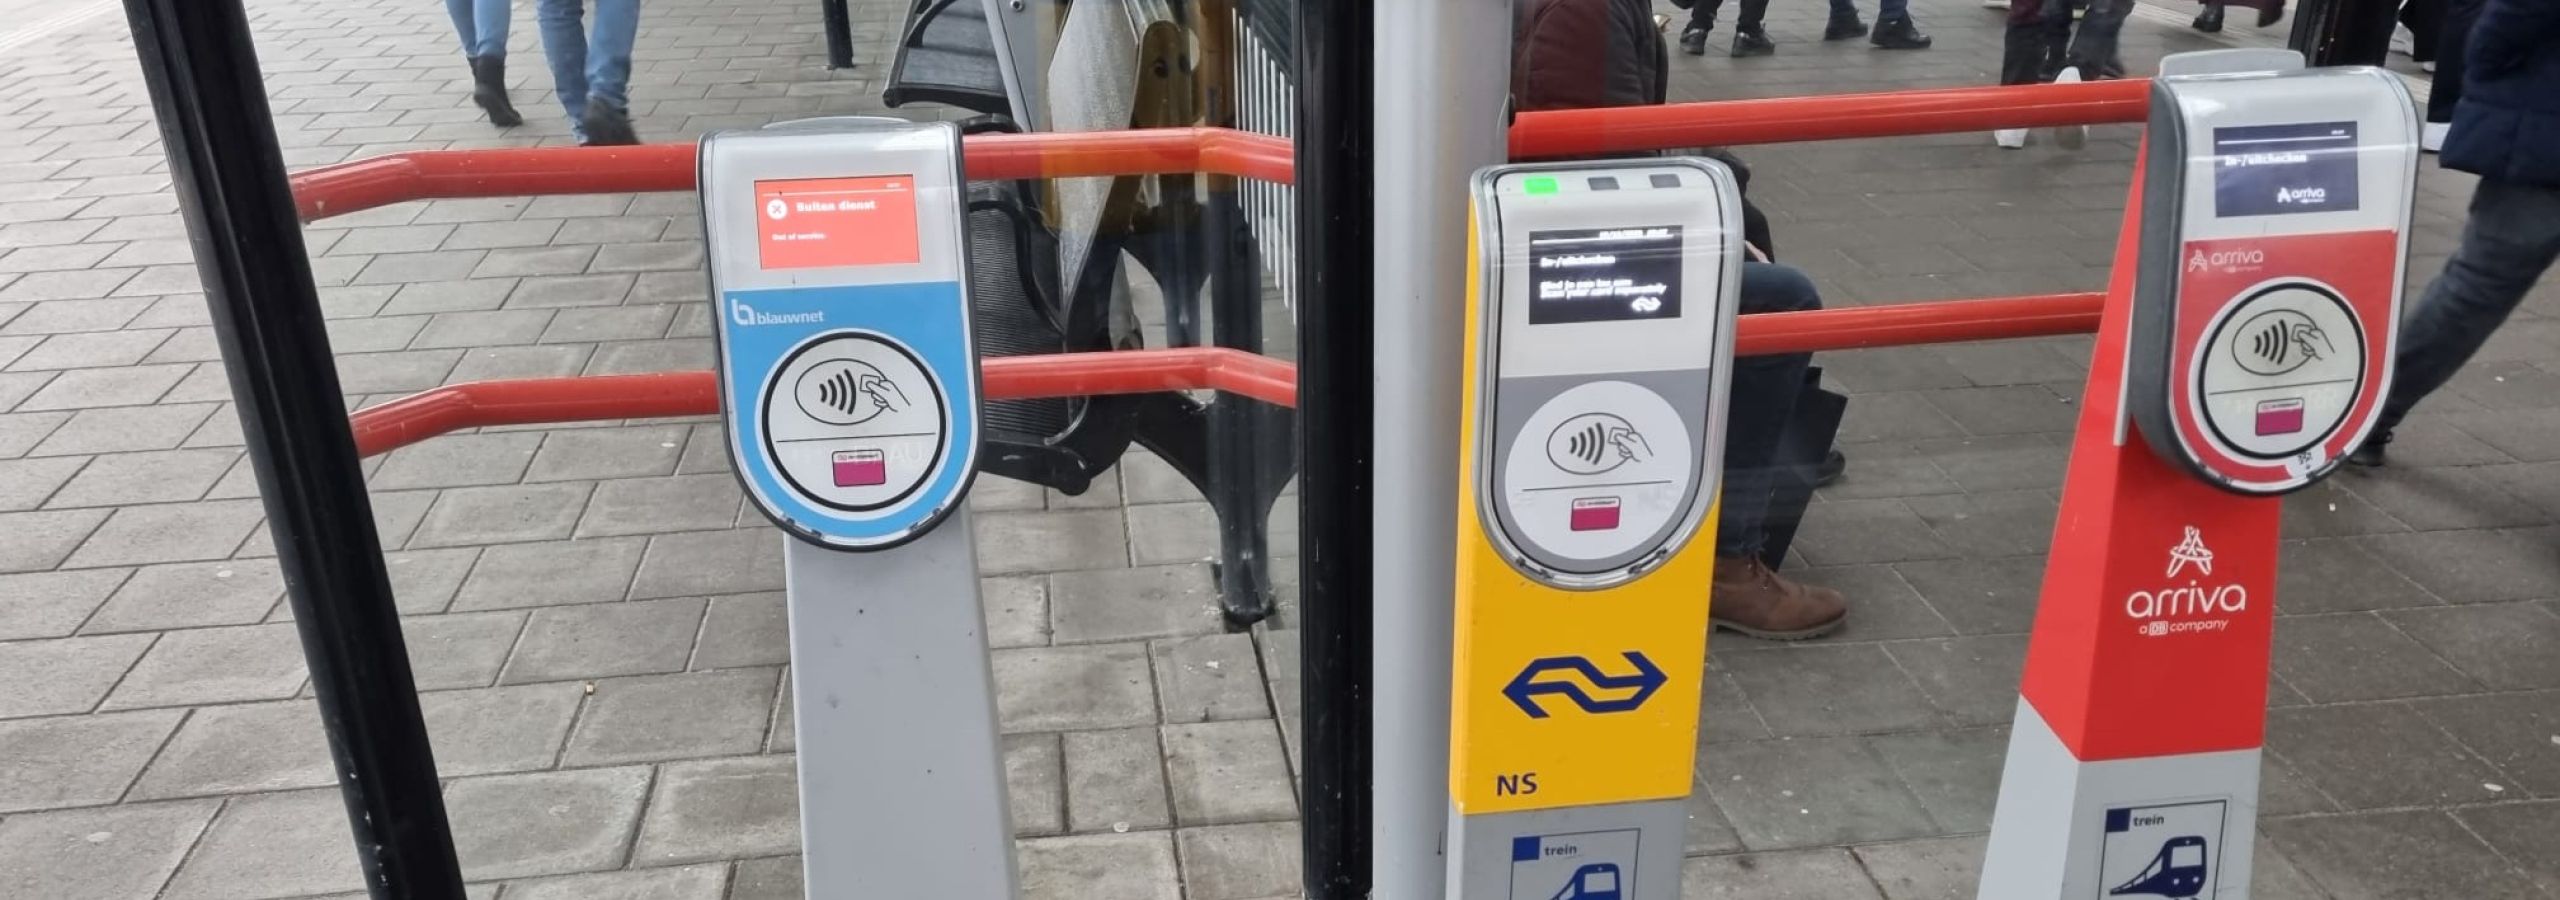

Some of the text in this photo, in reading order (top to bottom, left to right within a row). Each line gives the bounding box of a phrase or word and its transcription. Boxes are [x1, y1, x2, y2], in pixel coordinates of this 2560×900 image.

[2291, 187, 2325, 199] arriva
[2211, 248, 2264, 266] arriva
[757, 310, 824, 325] blauwnet
[2127, 580, 2246, 618] arriva
[2170, 619, 2229, 632] company
[1496, 772, 1538, 796] NS
[2133, 815, 2165, 827] trein
[1544, 844, 1577, 857] trein
